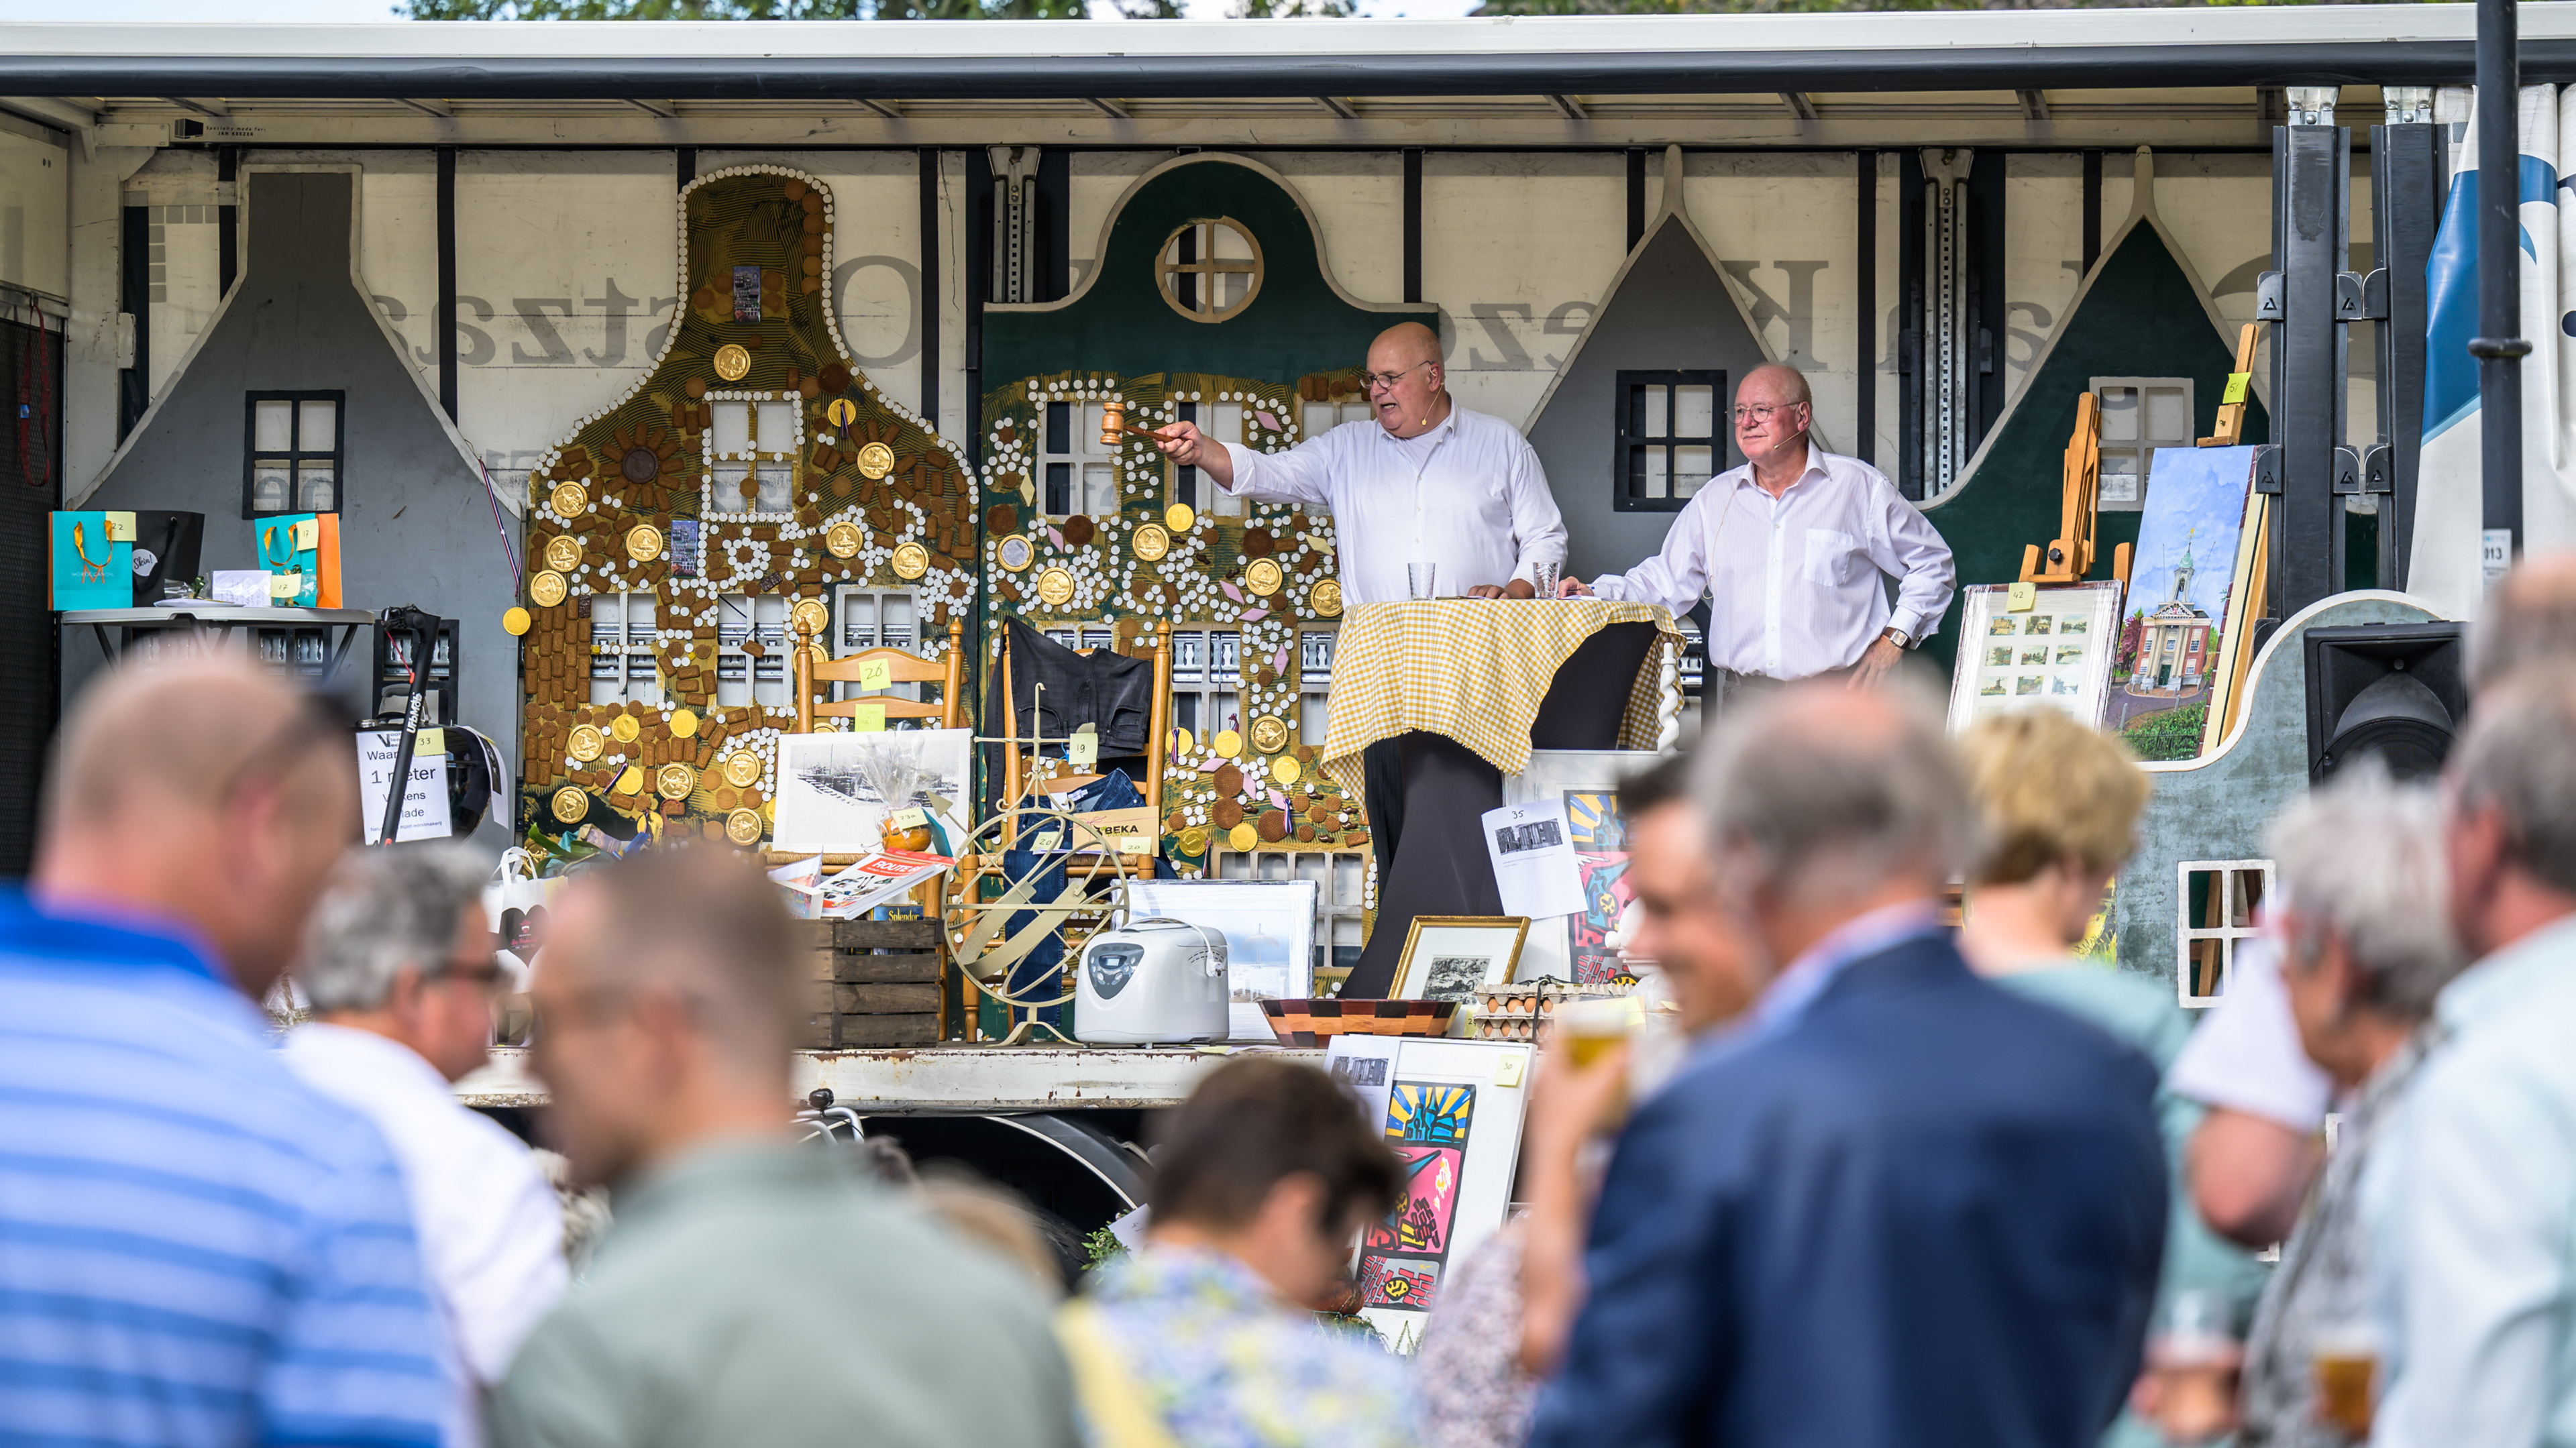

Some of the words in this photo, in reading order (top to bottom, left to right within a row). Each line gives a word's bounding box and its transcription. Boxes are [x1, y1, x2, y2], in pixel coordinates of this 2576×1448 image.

[2229, 382, 2239, 393] 51
[111, 522, 123, 531] 22
[303, 530, 309, 538] 17
[2484, 547, 2502, 560] 013
[133, 555, 154, 569] Skin!
[2013, 591, 2024, 599] 42
[865, 663, 883, 680] 26
[418, 737, 431, 745] 33
[1077, 744, 1085, 753] 19
[371, 770, 382, 784] 1
[1511, 810, 1525, 820] 35
[1105, 825, 1139, 834] BEKA
[872, 860, 913, 873] ROUTE
[888, 907, 919, 921] Splendor
[1503, 1062, 1513, 1070] 30
